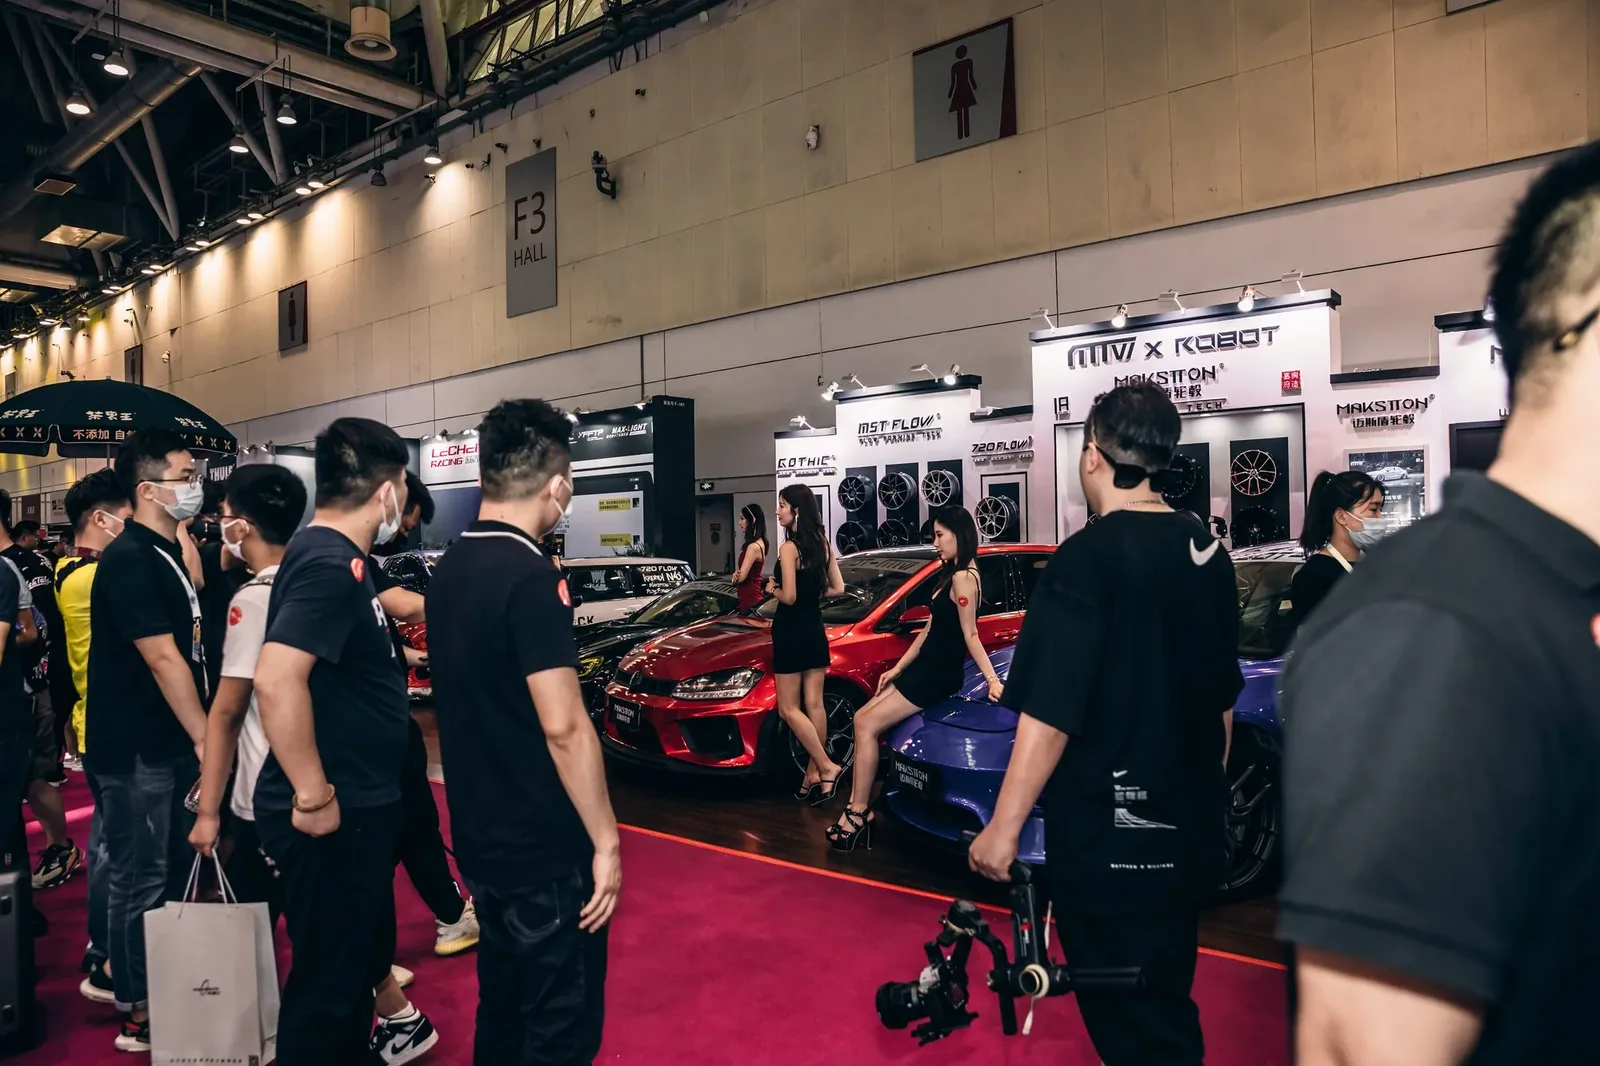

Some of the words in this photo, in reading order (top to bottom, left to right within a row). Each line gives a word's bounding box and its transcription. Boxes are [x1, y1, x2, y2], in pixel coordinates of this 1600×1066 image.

[514, 191, 546, 241] F3
[514, 243, 547, 268] HALL
[1175, 325, 1280, 358] ROBOT
[1187, 402, 1223, 412] TECH
[858, 420, 888, 434] MST
[73, 429, 110, 440] 不添加
[430, 457, 463, 468] RACING
[778, 455, 831, 468] GOTHIC
